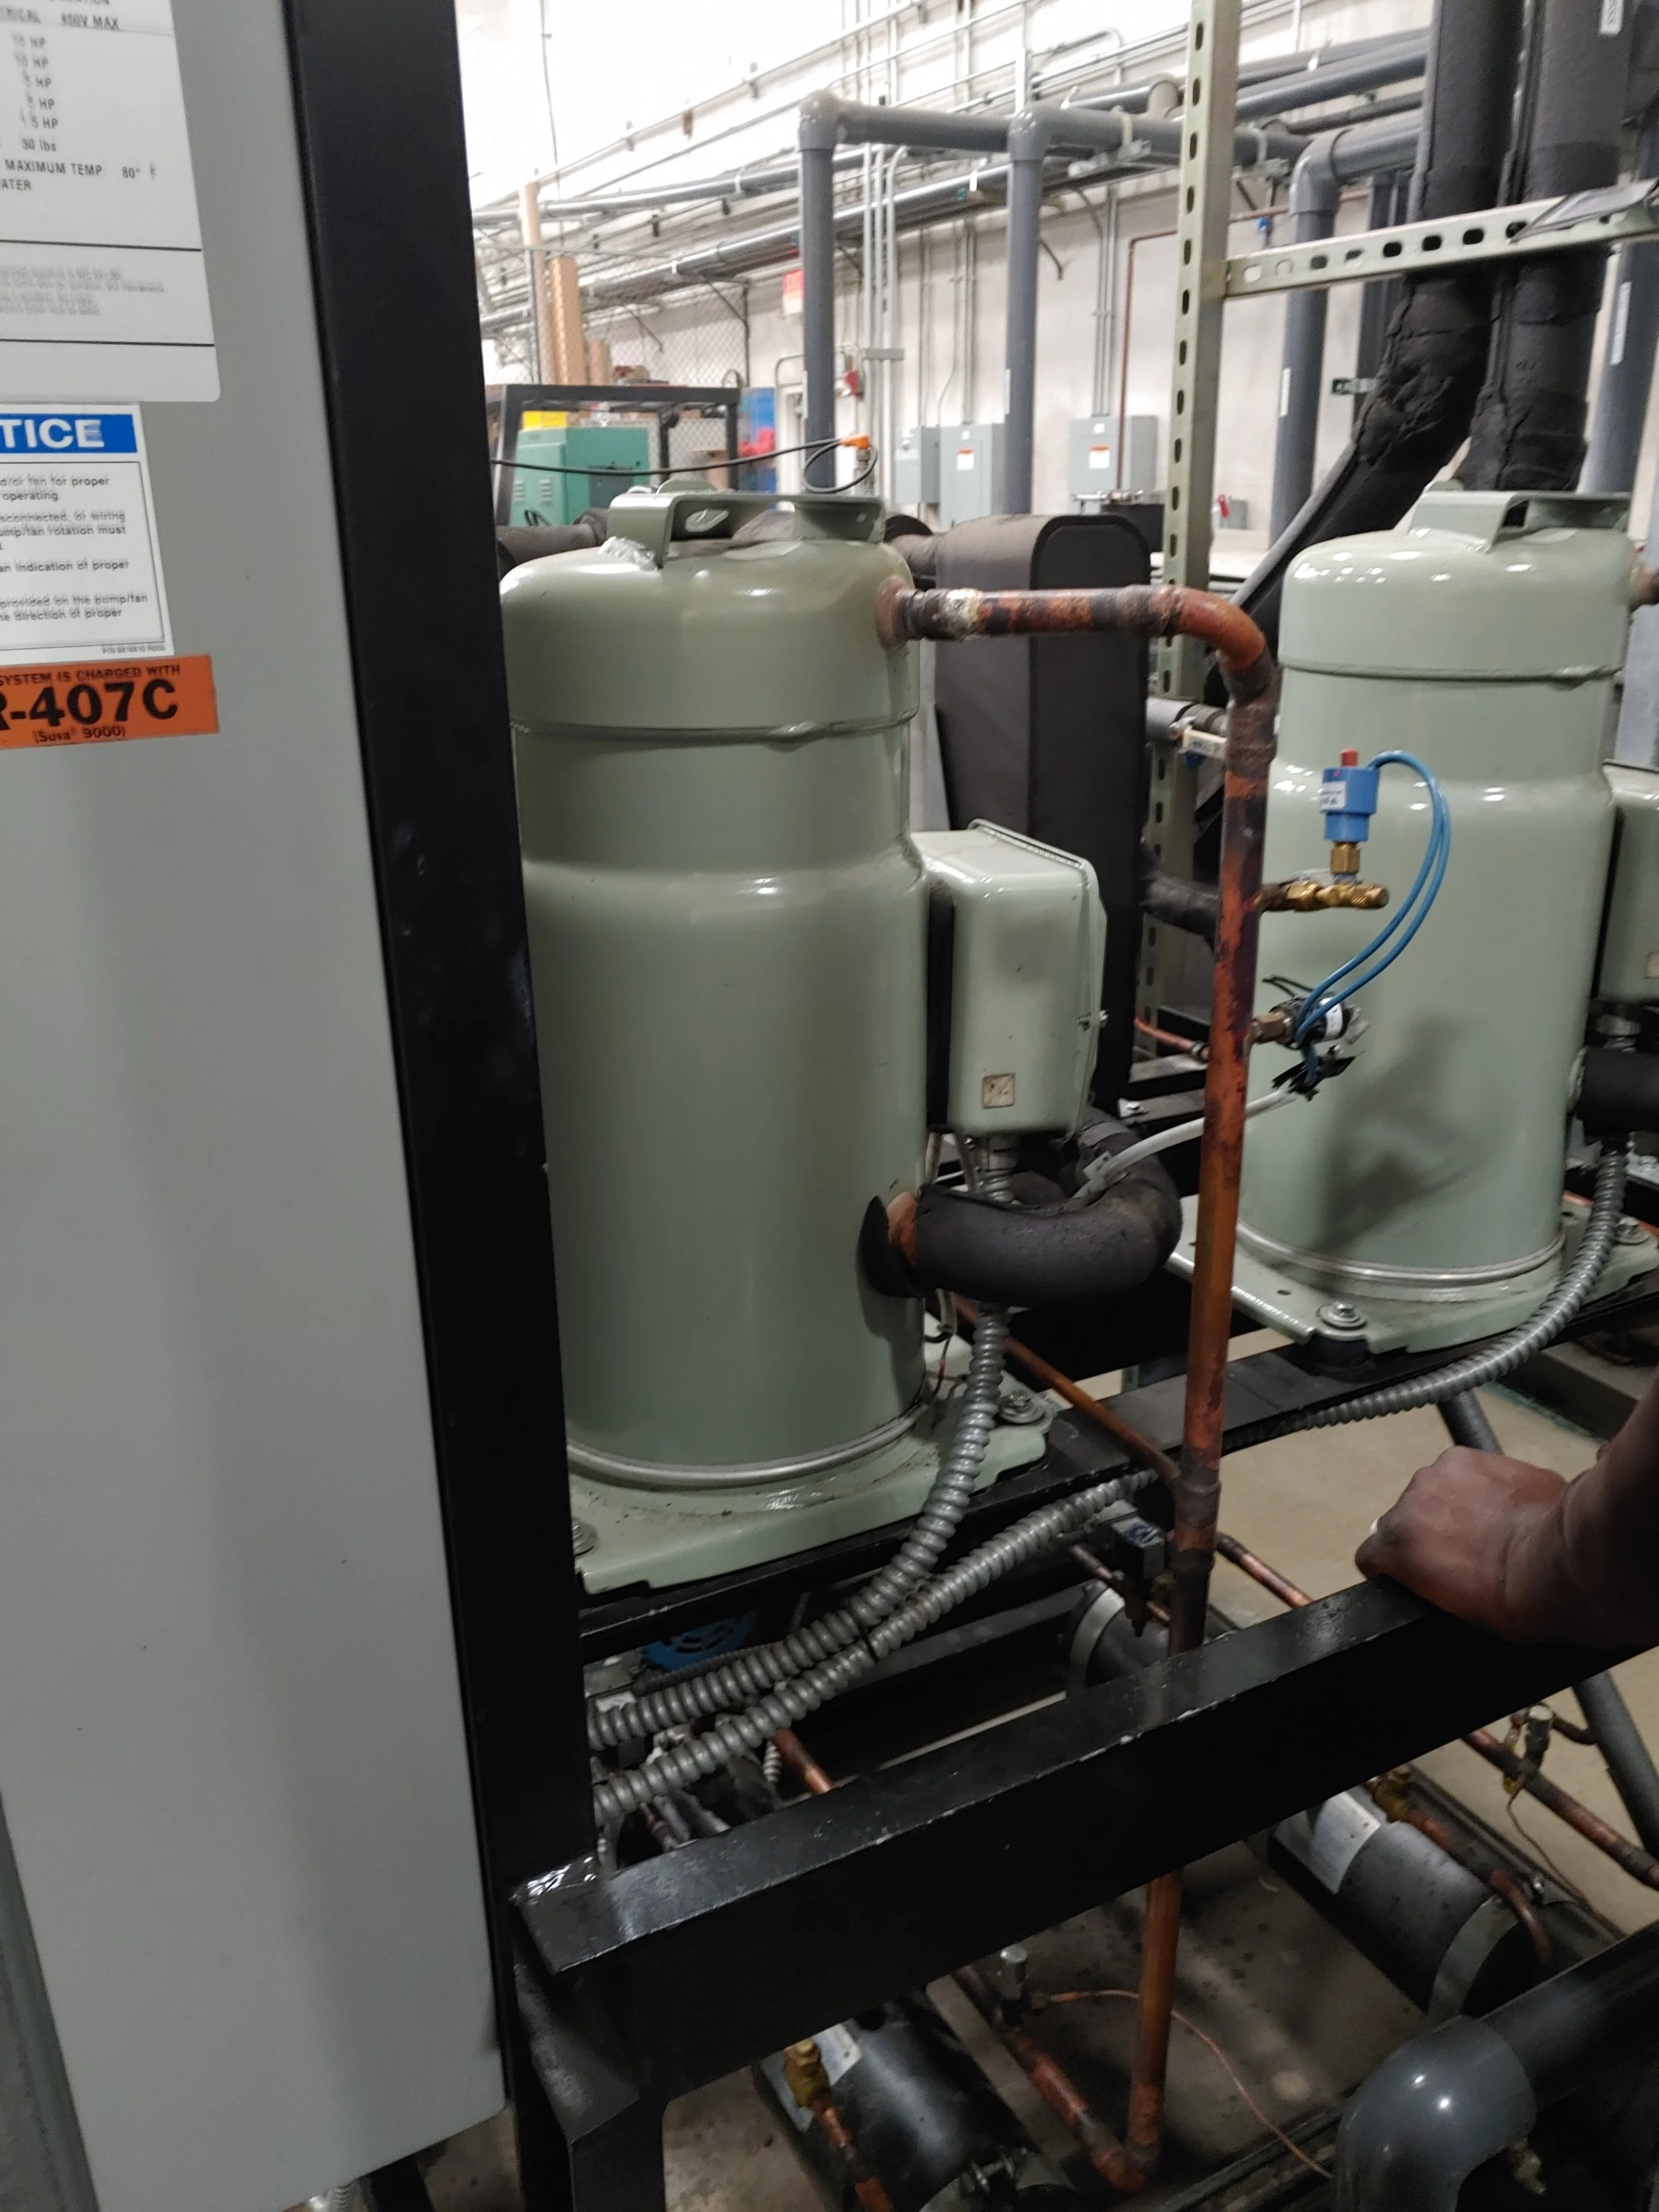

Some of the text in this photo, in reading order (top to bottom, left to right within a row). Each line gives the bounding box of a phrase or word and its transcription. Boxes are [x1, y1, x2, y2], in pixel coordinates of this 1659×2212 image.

[92, 15, 119, 31] MAX
[39, 98, 55, 110] HP
[42, 117, 59, 129] HP
[5, 159, 66, 174] MAXIMUM
[0, 419, 105, 449] TICE
[71, 476, 109, 488] proper
[91, 510, 126, 522] wiring
[48, 525, 94, 536] rotation
[98, 523, 126, 534] must
[15, 560, 73, 571] indication
[92, 562, 130, 571] proper
[72, 594, 90, 605] the
[15, 609, 66, 620] direction
[85, 610, 122, 619] proper
[58, 670, 71, 683] IS
[76, 666, 142, 681] CHARGED
[146, 664, 180, 676] WITH
[82, 725, 126, 739] 9000)
